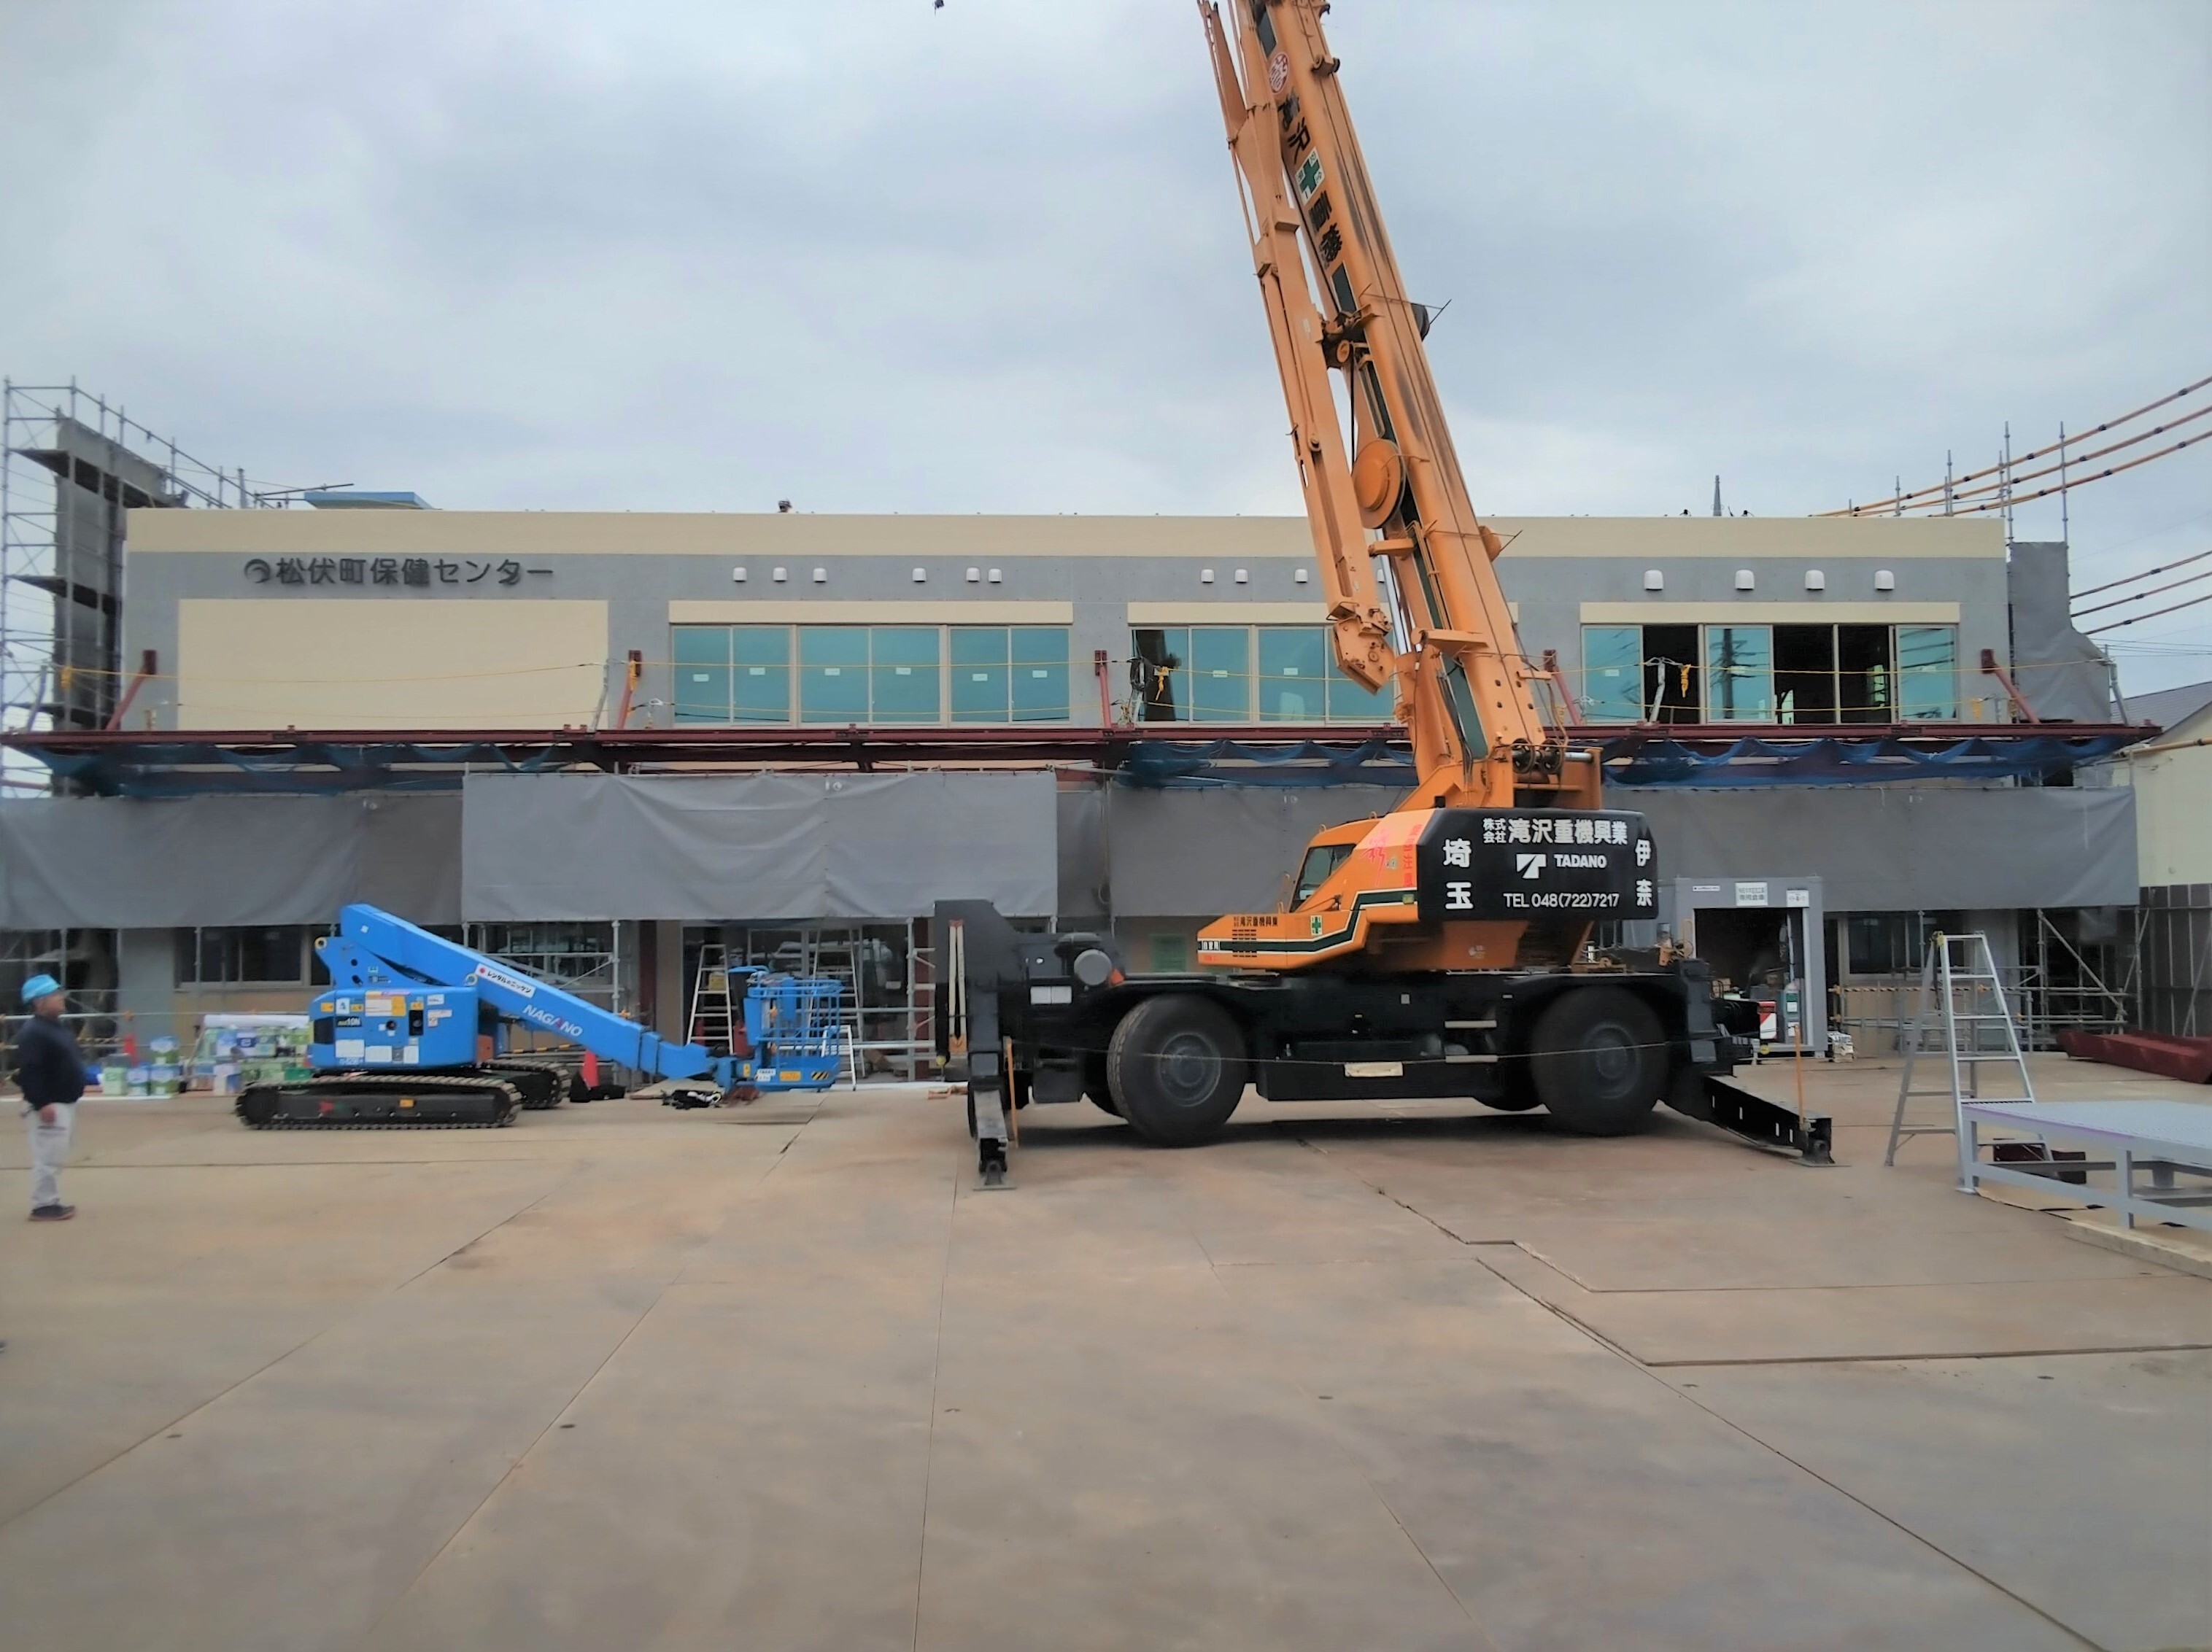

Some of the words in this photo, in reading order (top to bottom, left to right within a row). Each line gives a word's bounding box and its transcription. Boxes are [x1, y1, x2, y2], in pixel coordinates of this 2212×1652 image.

[276, 557, 554, 586] 松伏町保健センター
[1508, 818, 1628, 845] 滝沢重機興業
[1442, 838, 1474, 910] 埼玉
[1553, 854, 1607, 869] TADANO
[1635, 839, 1652, 907] 伊奈
[1503, 893, 1530, 908] TEL
[1531, 893, 1620, 908] 048(722)7217
[522, 1004, 584, 1037] NAGANO
